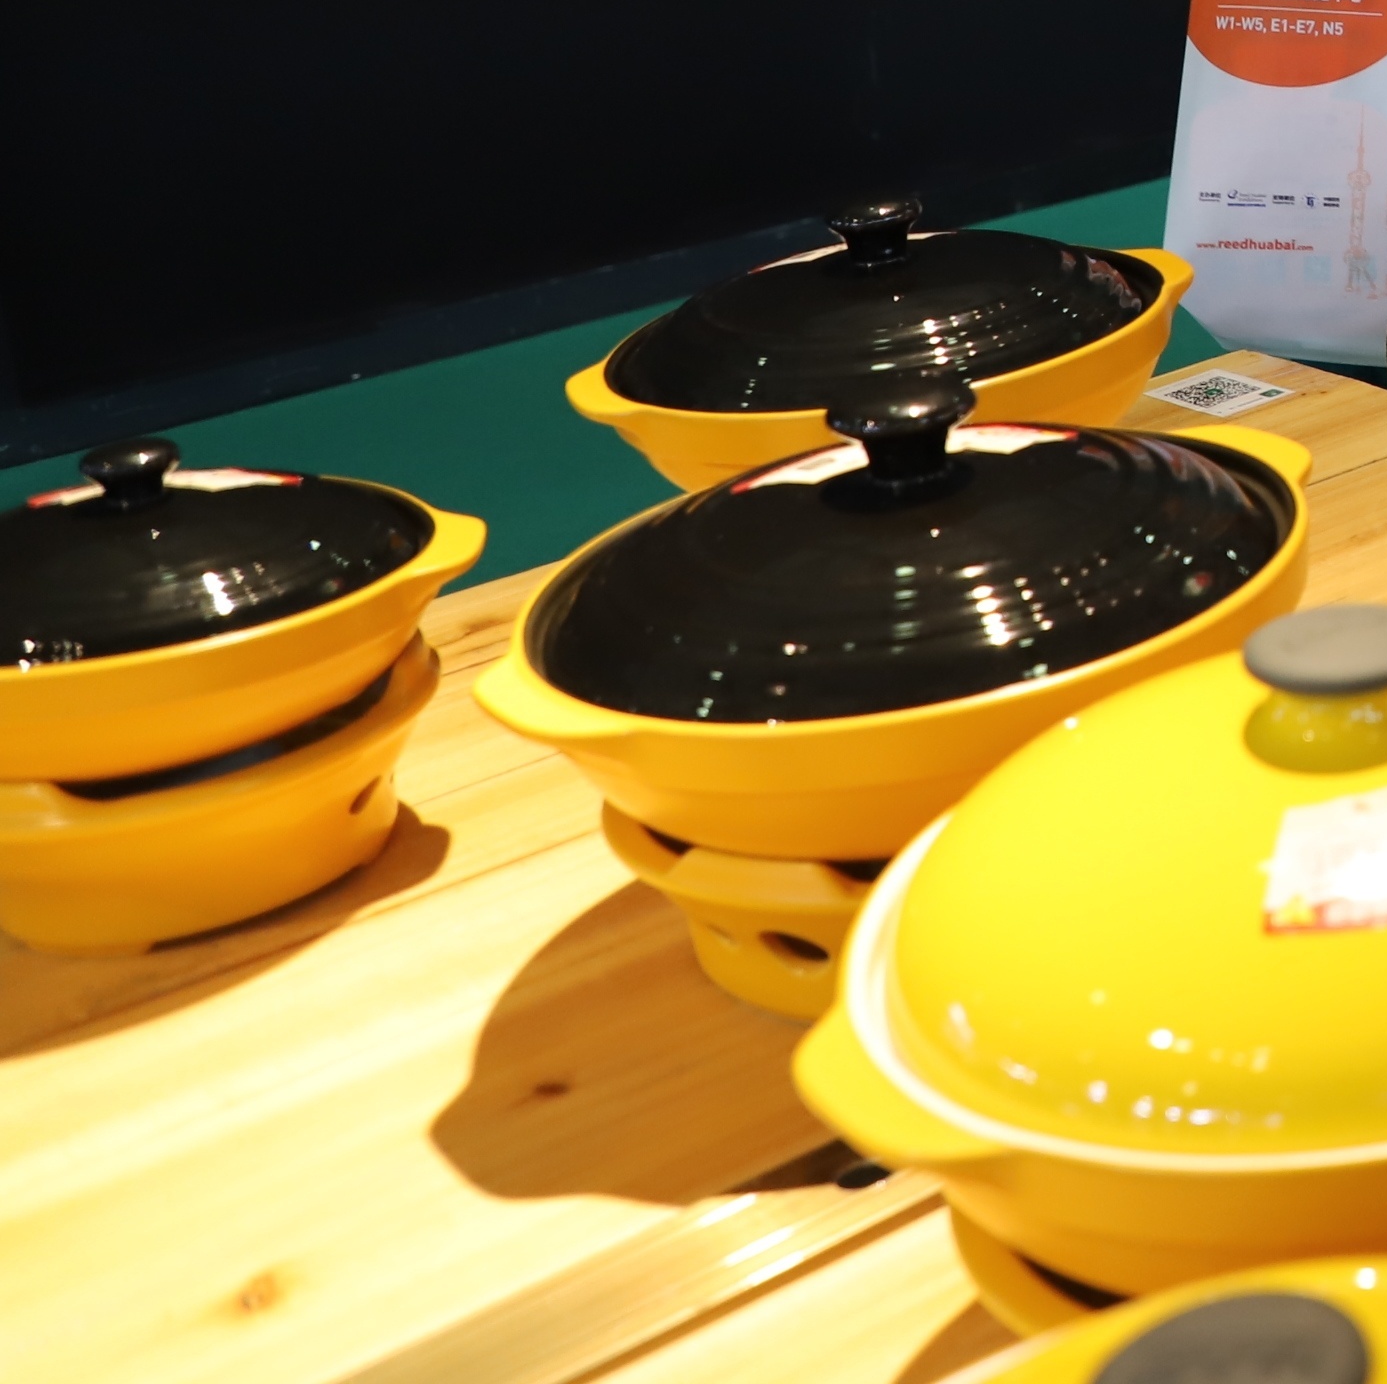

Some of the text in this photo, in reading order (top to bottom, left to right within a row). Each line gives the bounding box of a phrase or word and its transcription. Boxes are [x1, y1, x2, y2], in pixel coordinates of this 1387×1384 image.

[1216, 15, 1344, 36] W1-W5, E1-E7, N5
[1196, 238, 1314, 252] www.reedhuabai.com
